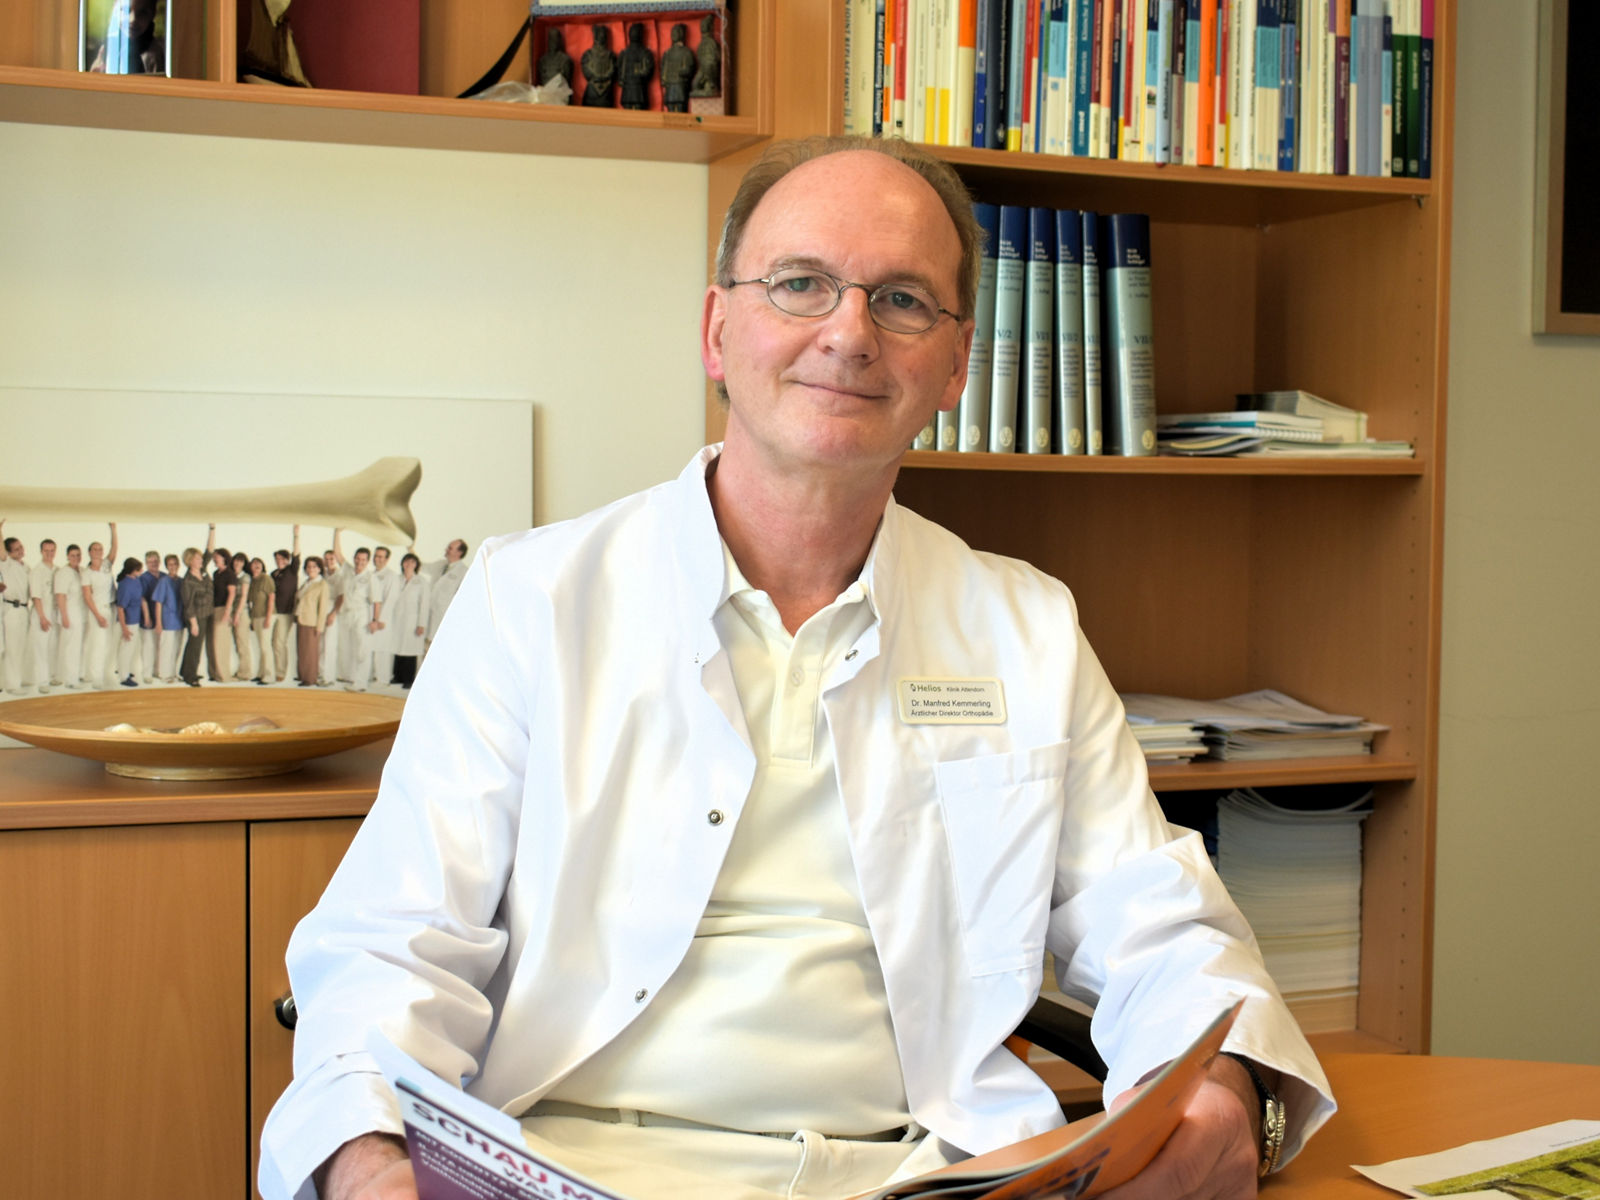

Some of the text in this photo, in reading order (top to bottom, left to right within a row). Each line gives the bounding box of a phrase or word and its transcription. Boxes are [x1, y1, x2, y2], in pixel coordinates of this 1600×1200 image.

[917, 684, 942, 692] Helios
[952, 700, 991, 708] Kemmerling
[412, 1101, 548, 1184] SCHAU
[503, 1166, 556, 1199] WAS
